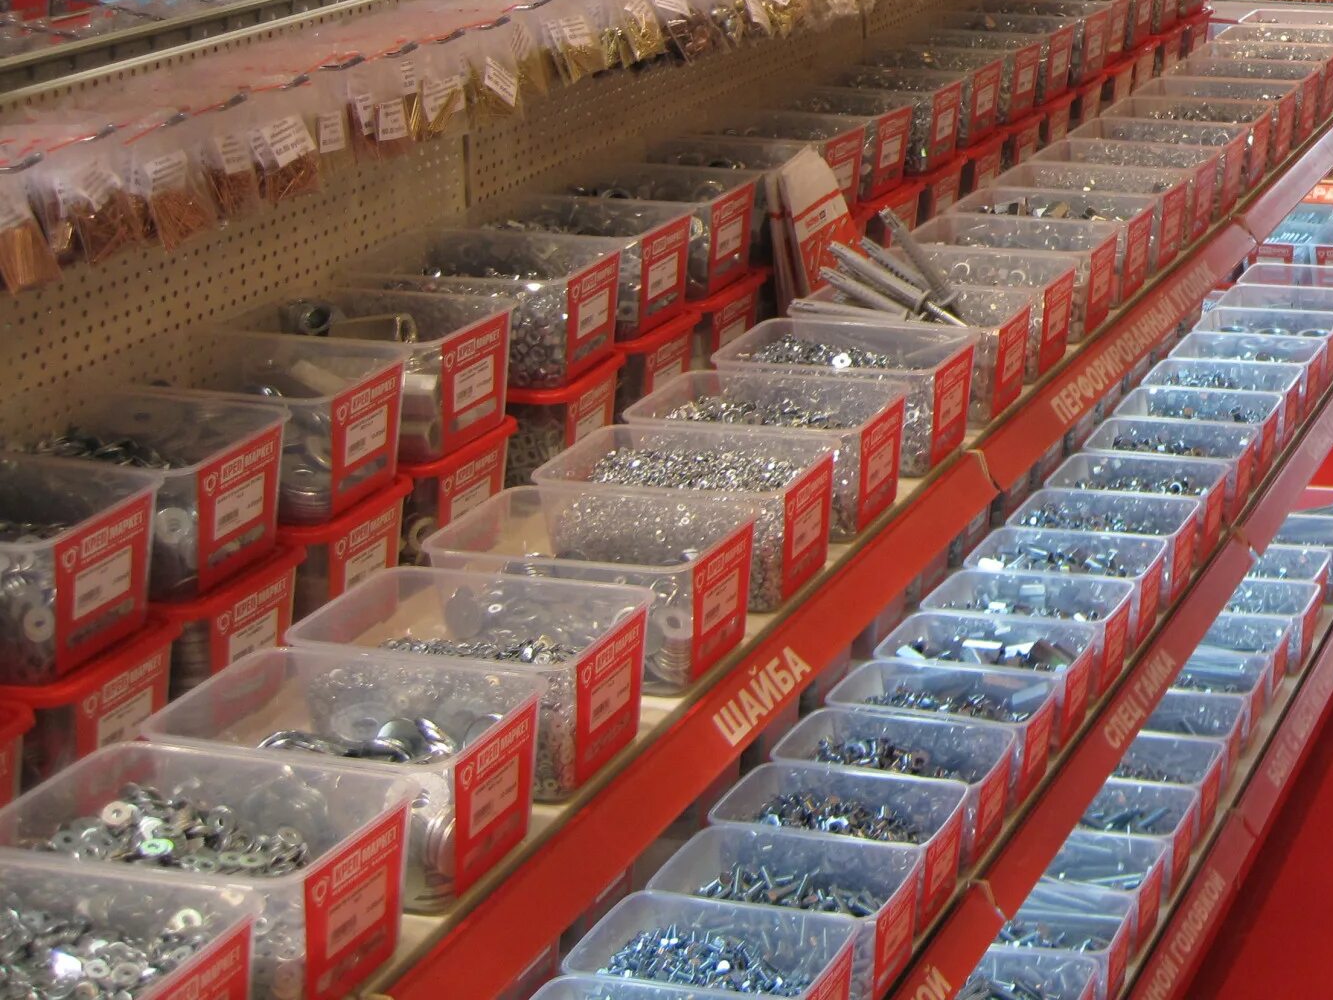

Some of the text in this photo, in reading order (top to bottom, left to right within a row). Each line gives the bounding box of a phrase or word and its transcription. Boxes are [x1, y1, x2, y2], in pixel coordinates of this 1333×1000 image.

[1050, 294, 1178, 424] ПЕРФОРИРОВАННЫЙ
[712, 646, 812, 747] ШАЙБА
[1104, 650, 1176, 749] СПЕЦ ГАЙКА
